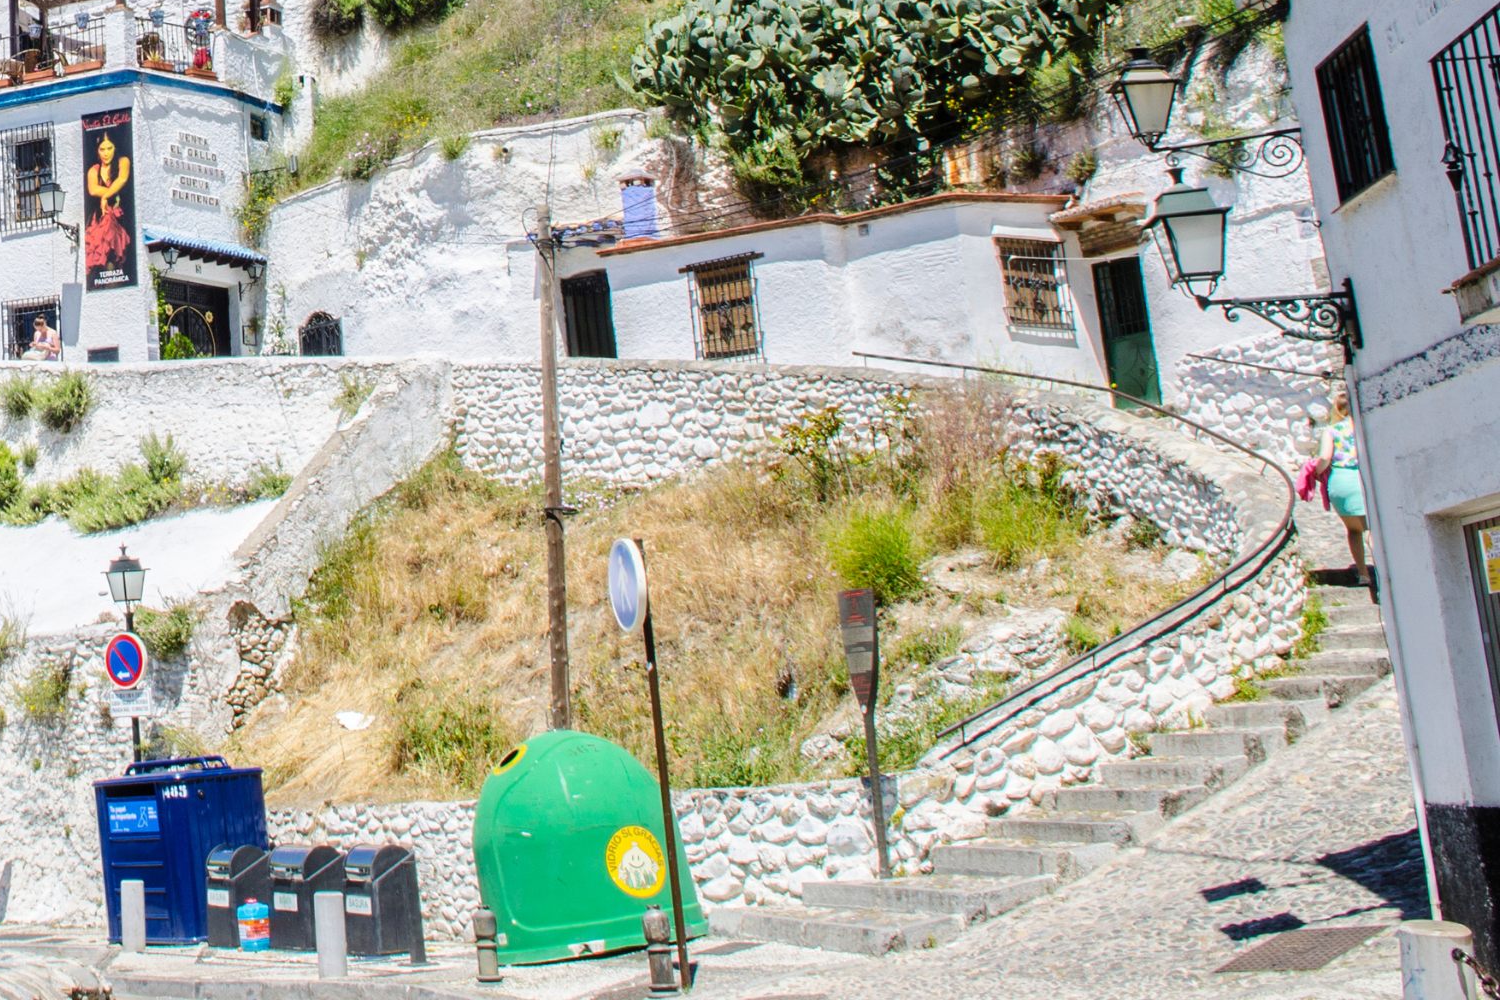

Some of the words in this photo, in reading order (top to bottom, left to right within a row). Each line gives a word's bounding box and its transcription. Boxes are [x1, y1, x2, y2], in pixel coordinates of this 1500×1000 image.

[170, 144, 182, 154] EL
[187, 148, 217, 162] GALLO
[163, 157, 225, 179] RESTAURANTE
[180, 176, 209, 190] CUEVA
[607, 834, 622, 873] VIDRIO
[633, 826, 665, 867] GRACIAS
[348, 897, 370, 910] BASURA
